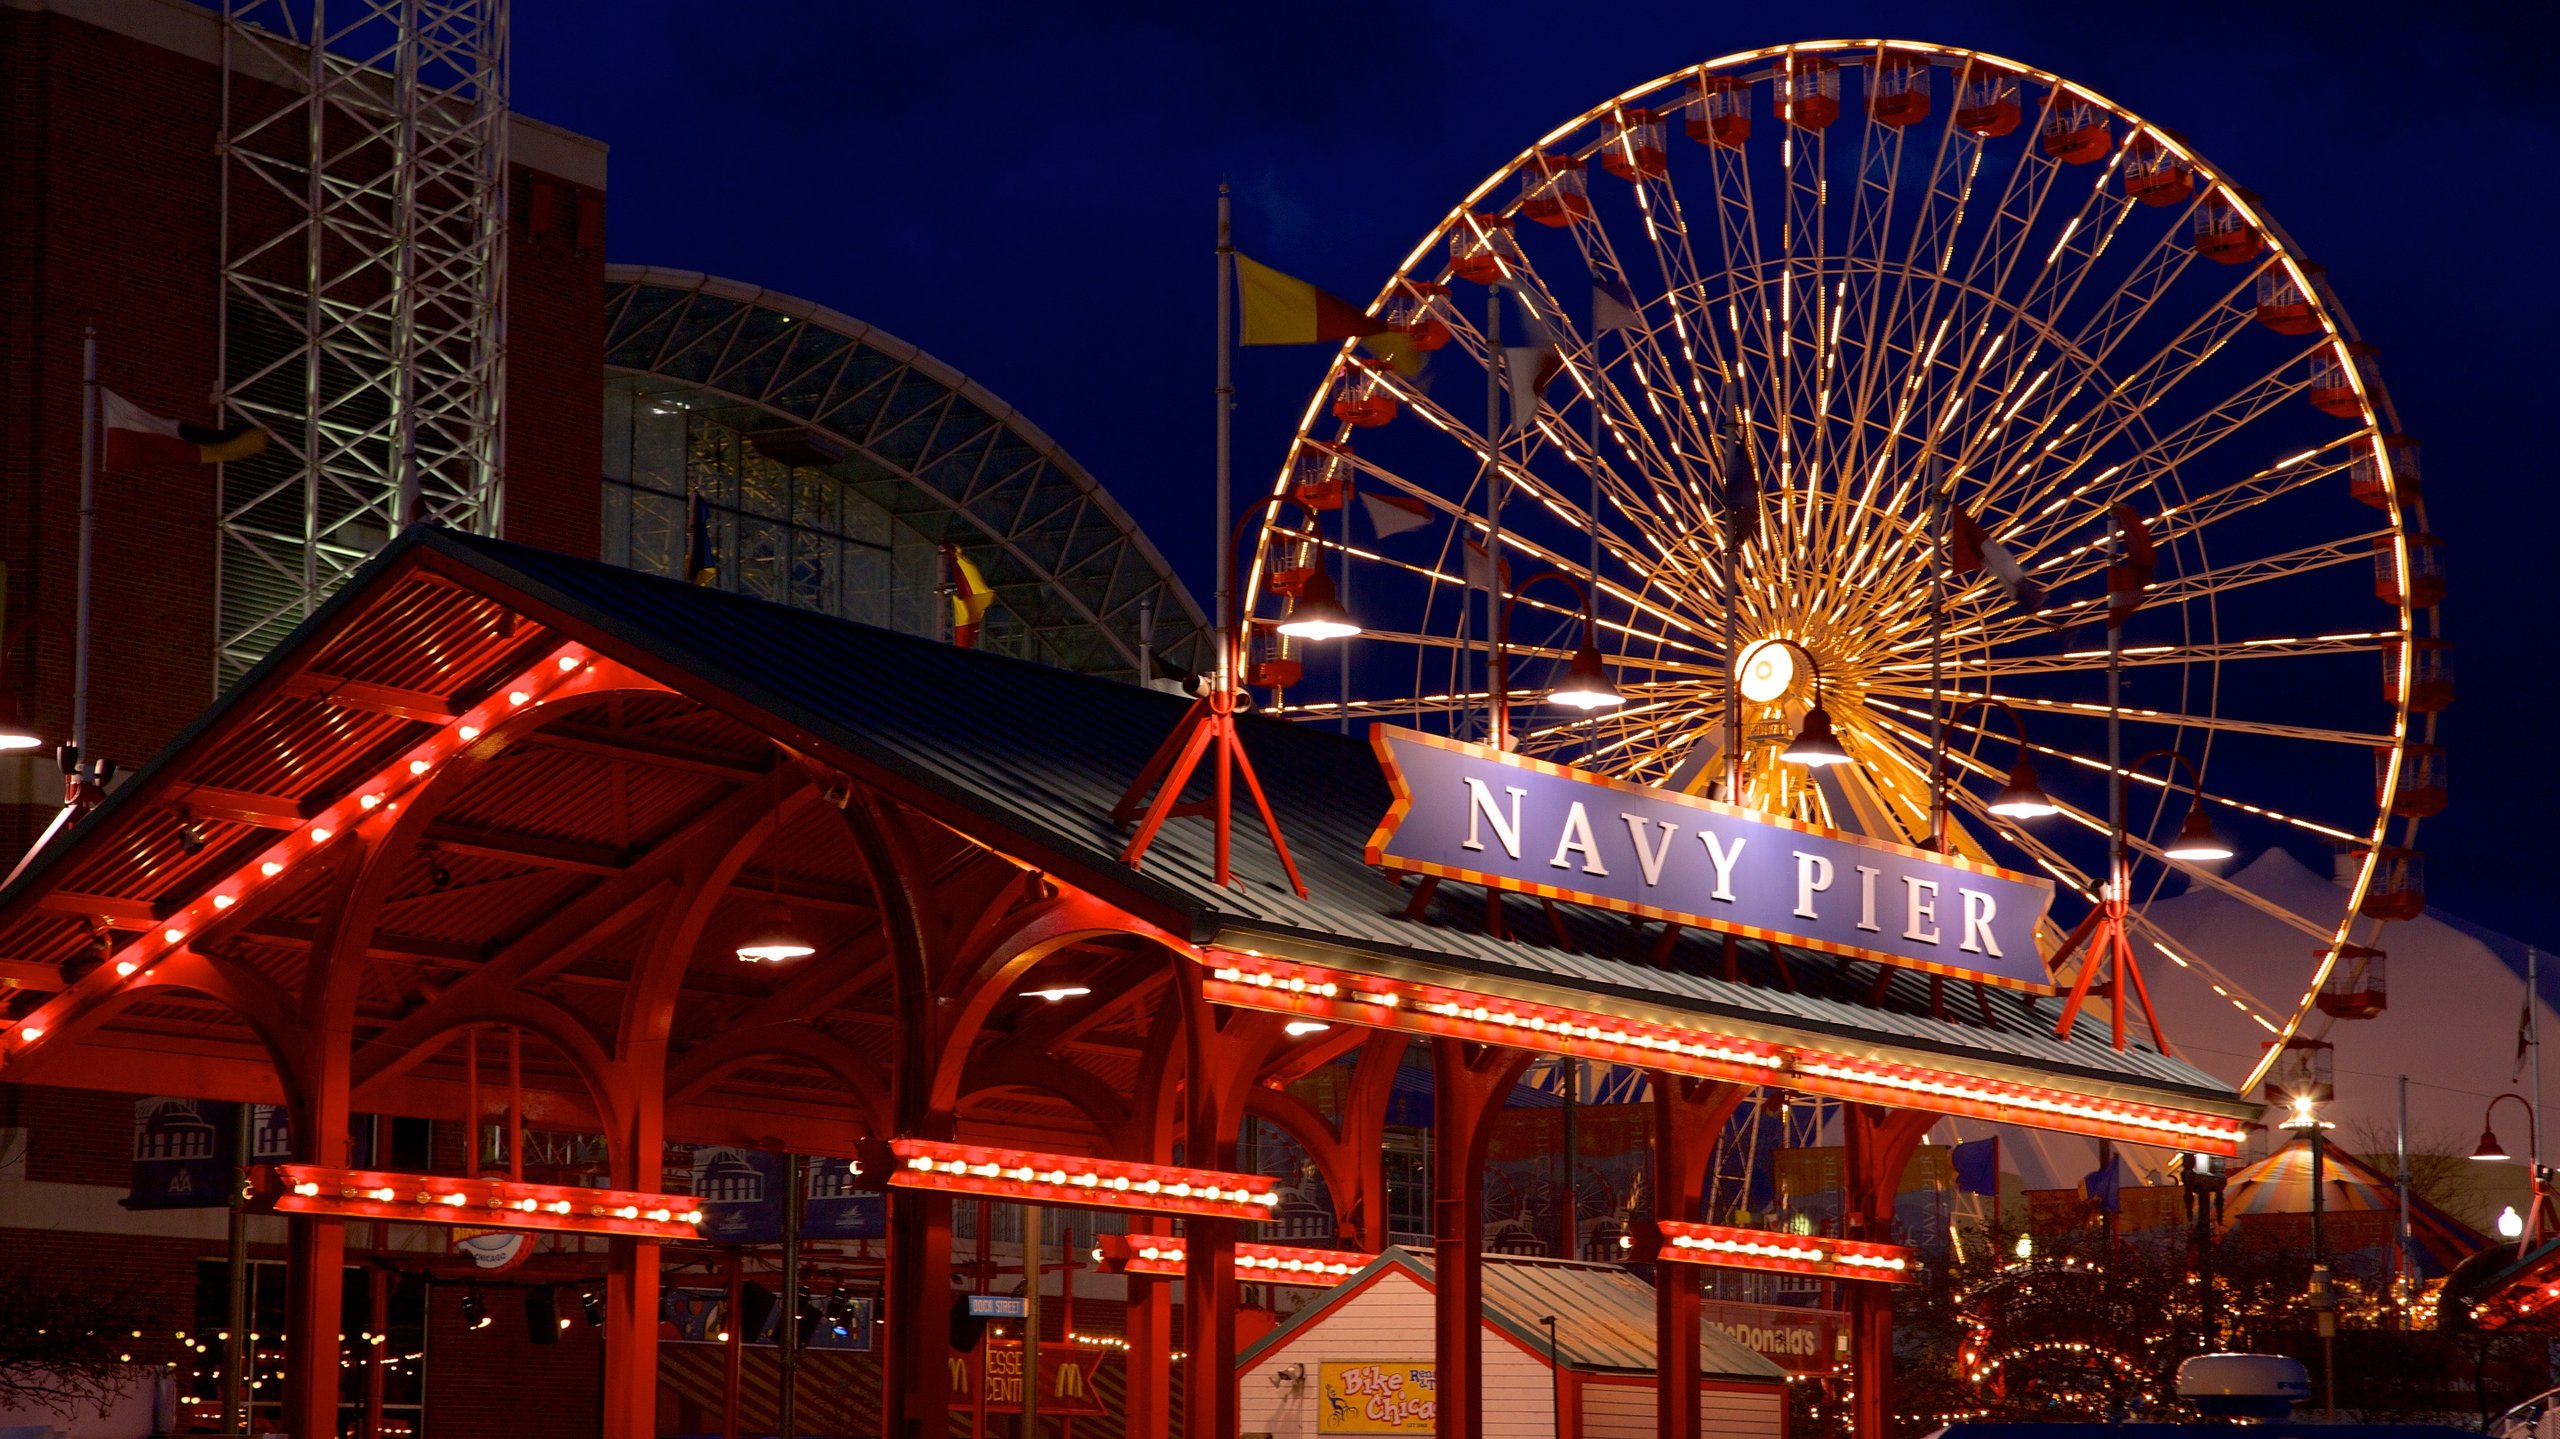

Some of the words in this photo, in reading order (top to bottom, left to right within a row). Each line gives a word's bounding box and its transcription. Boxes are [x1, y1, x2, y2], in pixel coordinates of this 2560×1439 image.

[1461, 776, 1747, 902] NAVY
[1793, 850, 2004, 959] PIER
[973, 1299, 993, 1313] DOCK
[995, 1300, 1020, 1314] STREET
[1709, 1321, 1816, 1356] cDonald's
[1341, 1366, 1404, 1397] Bike
[1366, 1391, 1437, 1426] Chica
